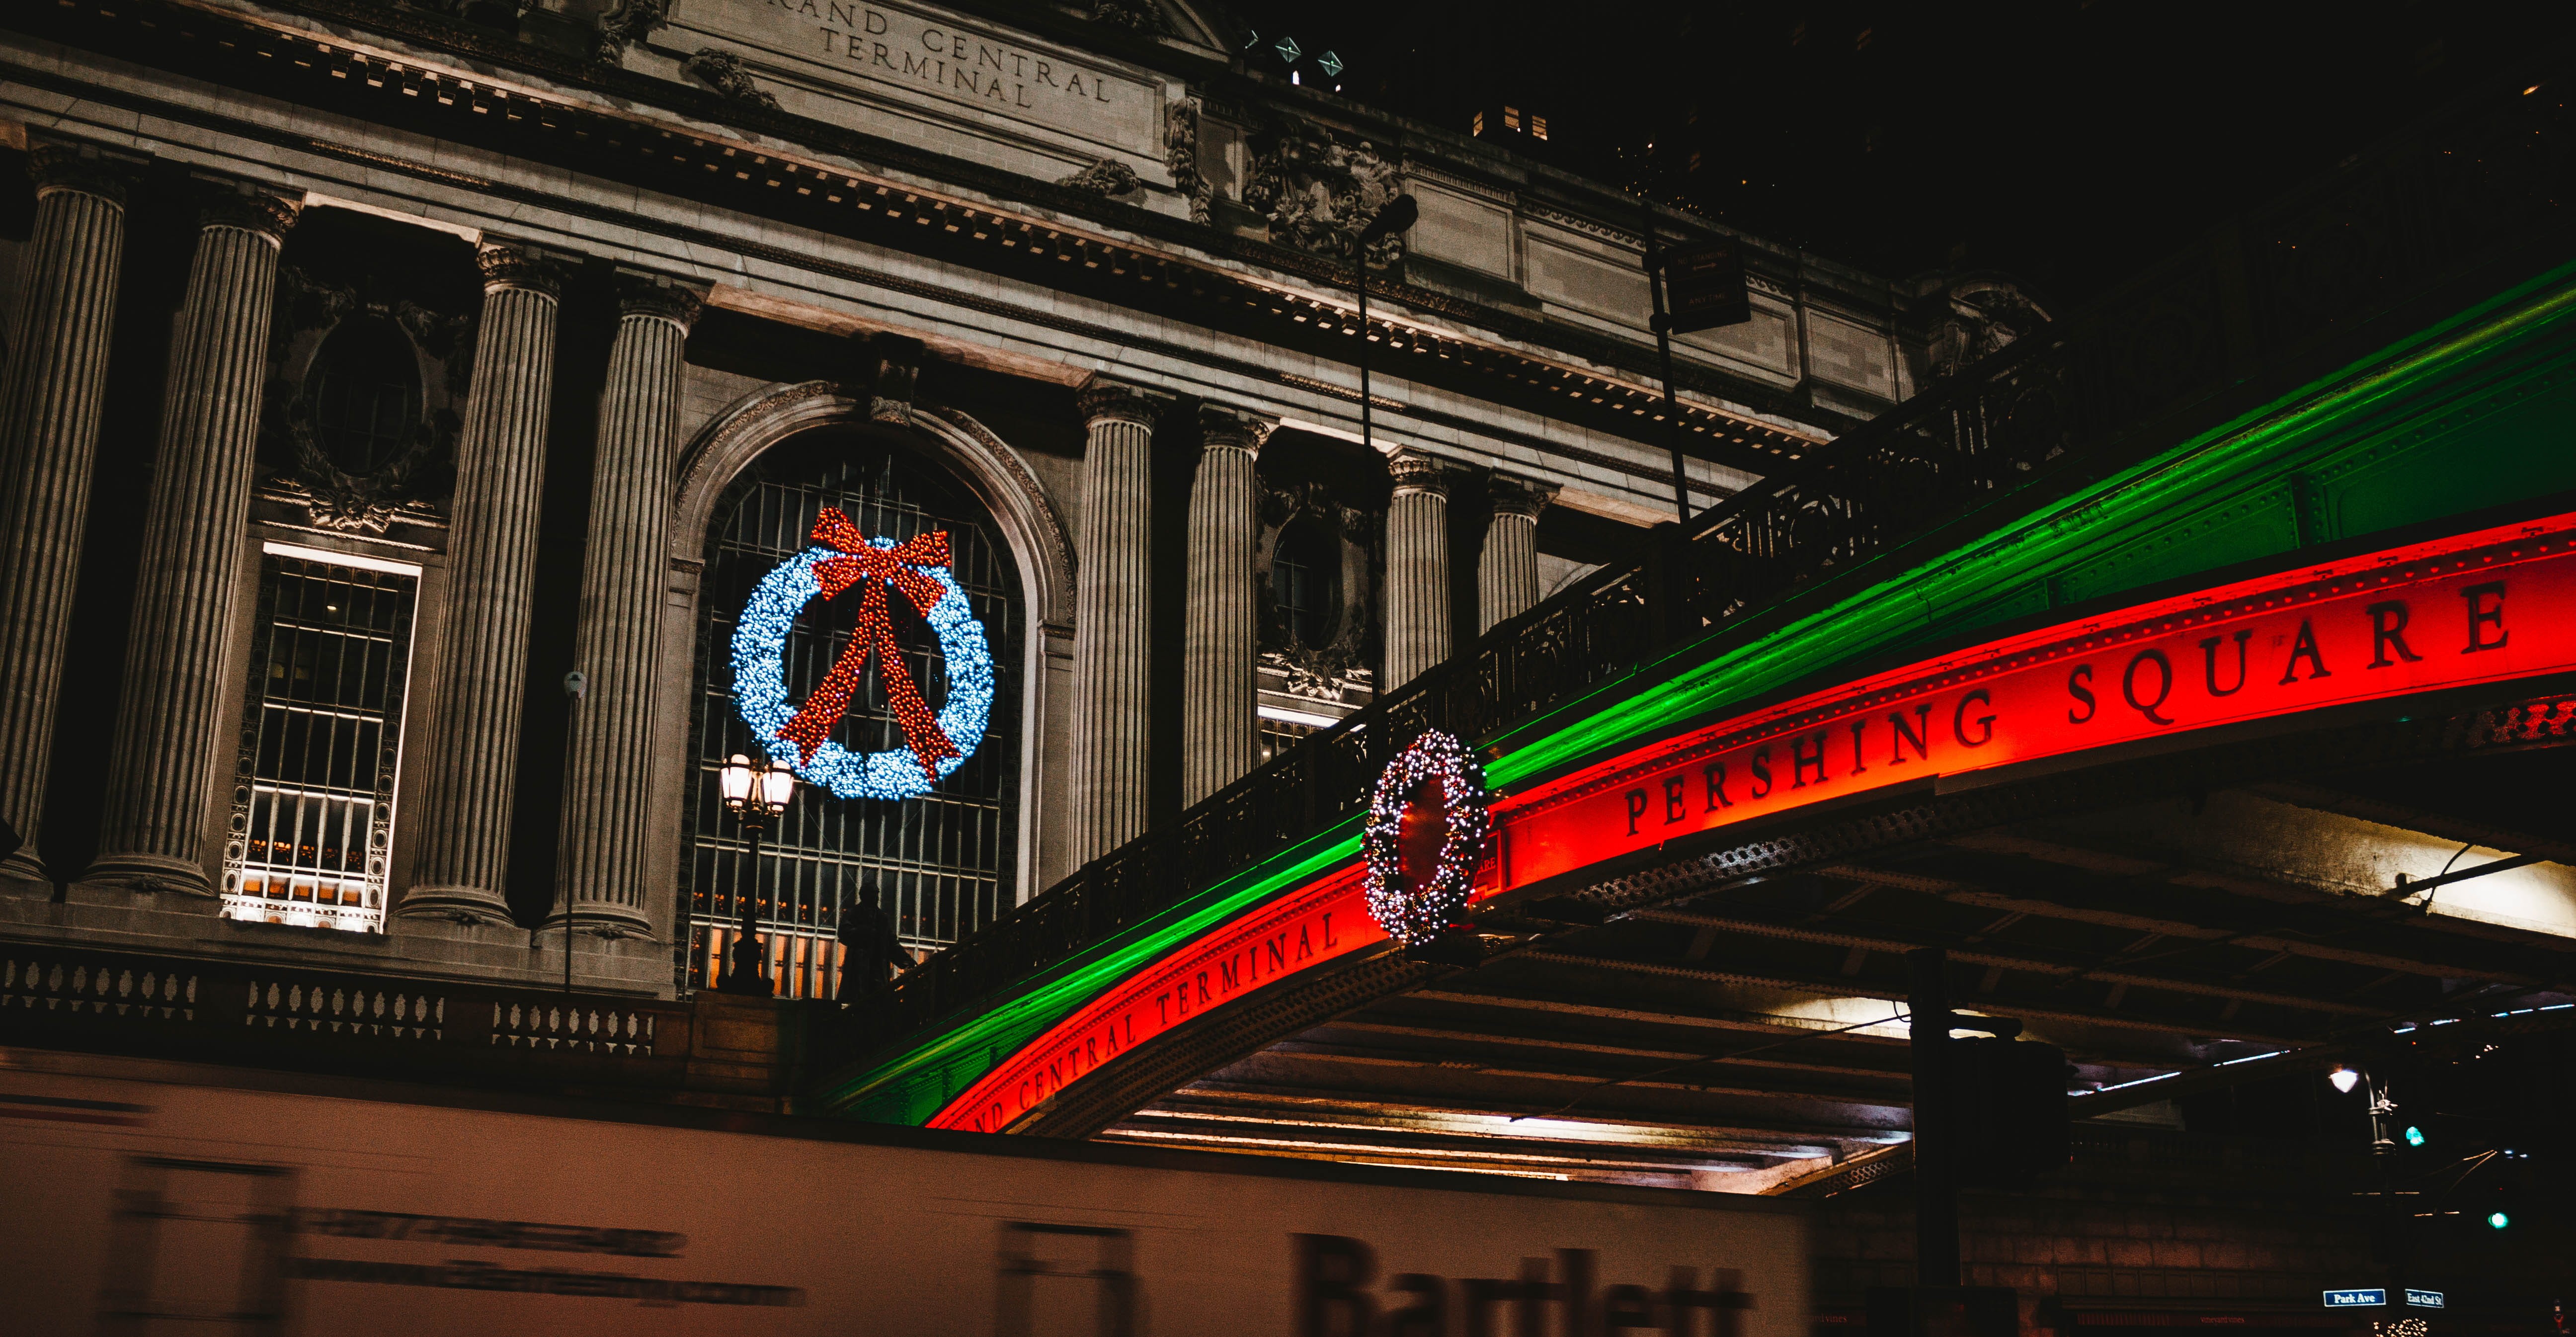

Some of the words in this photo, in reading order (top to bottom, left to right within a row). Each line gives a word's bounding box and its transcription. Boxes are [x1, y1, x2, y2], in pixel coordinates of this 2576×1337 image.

[768, 0, 886, 35] AND
[922, 29, 1110, 102] CENTRAL
[820, 27, 1031, 108] TERMINAL
[1623, 689, 1997, 838] PERSHING
[2068, 580, 2509, 725] SQUARE
[1019, 1014, 1136, 1111] CENTRAL
[1157, 913, 1338, 1026] TERMINAL
[1288, 1233, 1756, 1337] Bartlett
[2334, 1294, 2356, 1303] Park
[2357, 1293, 2375, 1303] Ave
[2407, 1293, 2421, 1303] East
[2421, 1295, 2435, 1304] 42nd
[2435, 1296, 2442, 1305] St
